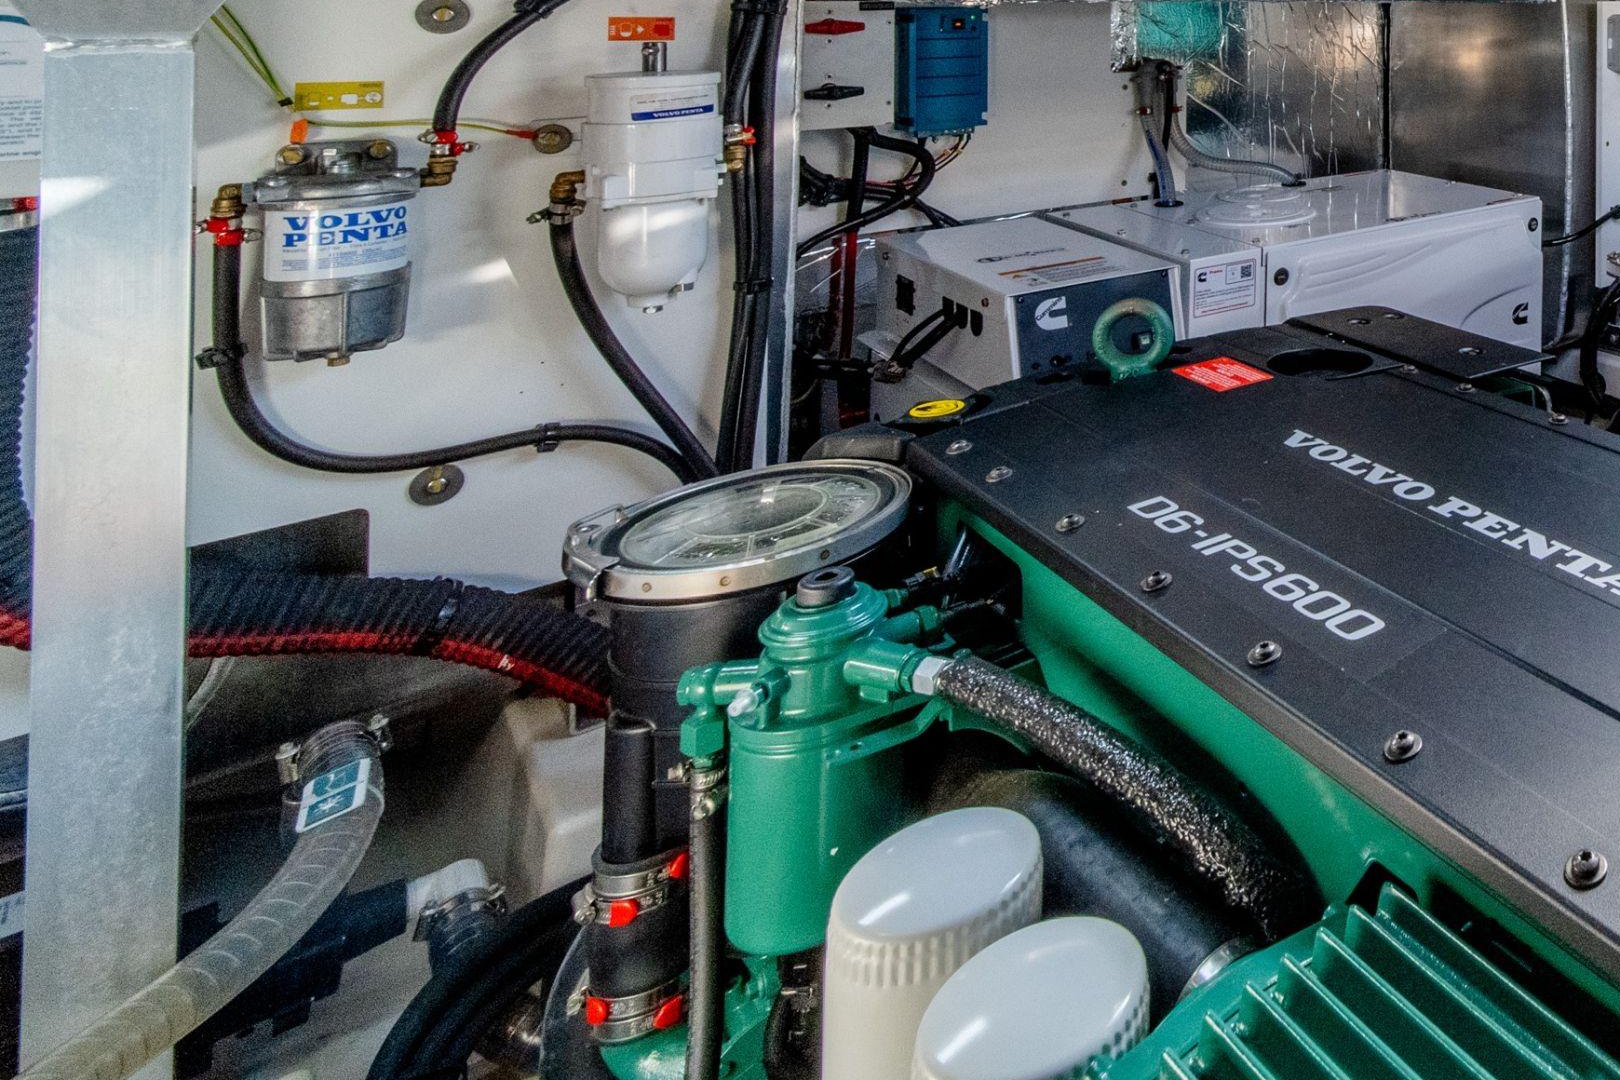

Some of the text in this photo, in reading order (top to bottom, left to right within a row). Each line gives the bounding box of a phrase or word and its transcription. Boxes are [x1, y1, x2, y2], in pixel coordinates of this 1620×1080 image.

[653, 107, 704, 118] VOLVO PENTA
[283, 206, 407, 231] VOLVO
[282, 221, 407, 248] PENTA
[1034, 296, 1063, 321] Cummins
[1283, 429, 1436, 501] VOLVO
[1126, 495, 1386, 641] D6-IPS600
